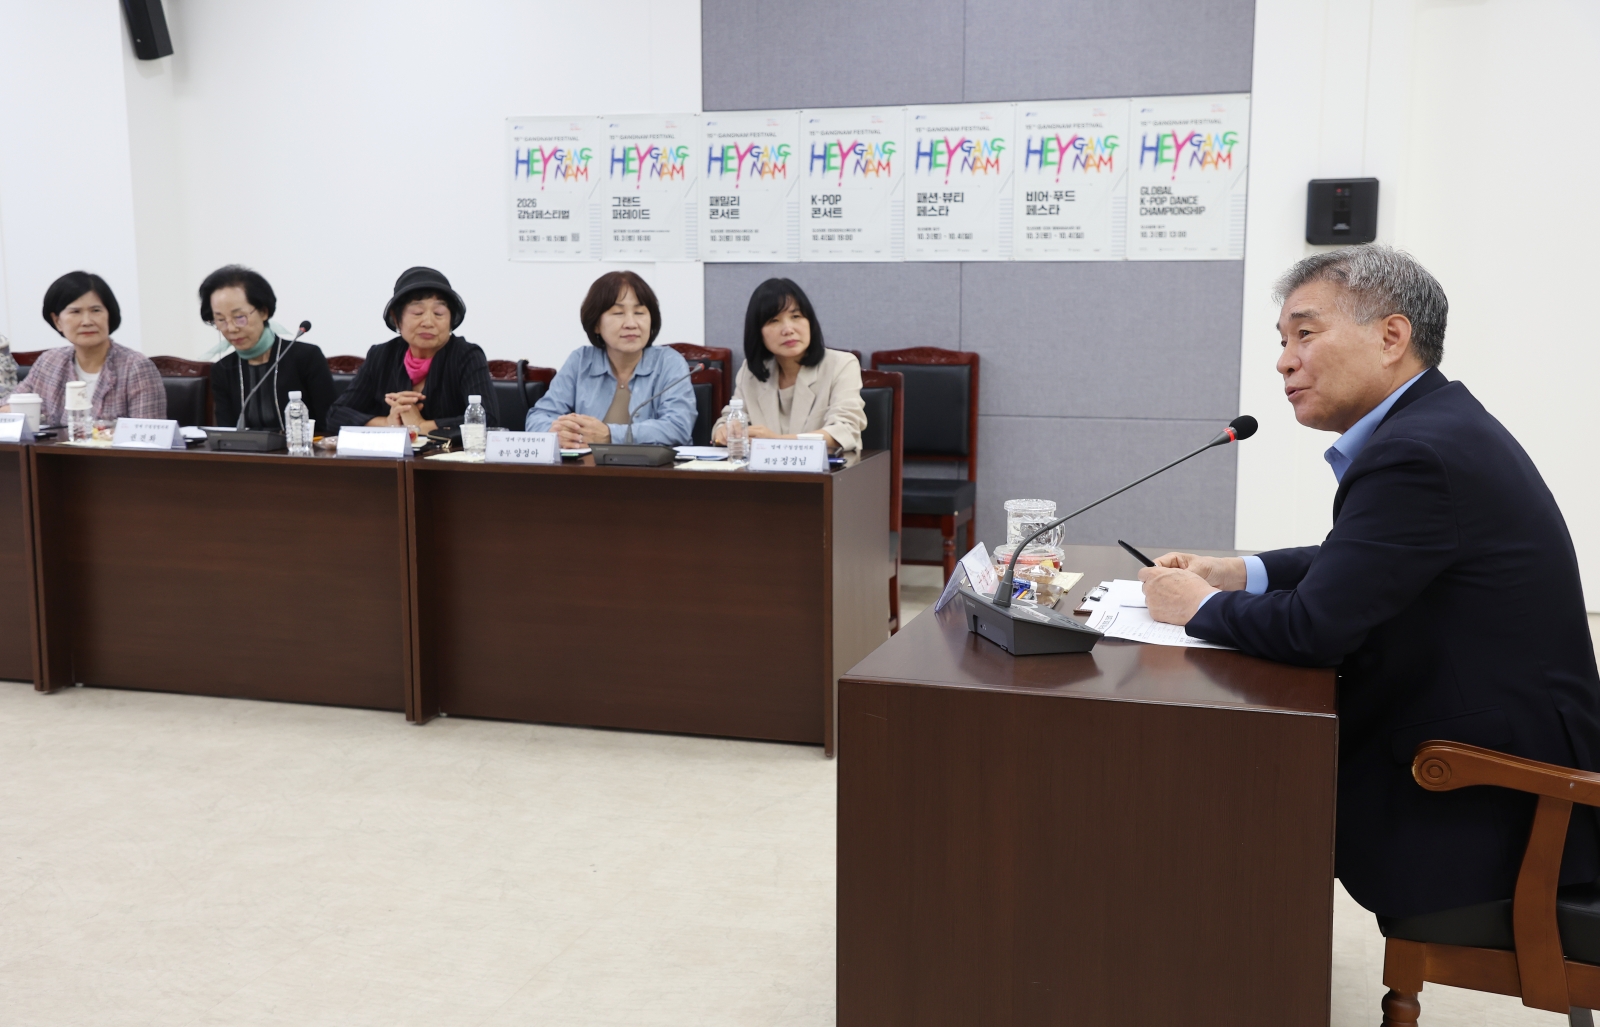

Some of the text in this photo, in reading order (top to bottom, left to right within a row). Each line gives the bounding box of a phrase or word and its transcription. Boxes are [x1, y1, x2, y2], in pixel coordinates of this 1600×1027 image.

[961, 138, 1006, 158] GANG
[1072, 135, 1120, 156] GANG
[1189, 132, 1239, 154] GANG
[553, 147, 593, 167] GANG
[650, 145, 689, 166] GANG
[750, 144, 792, 163] GANG
[853, 141, 896, 161] GANG
[853, 158, 891, 178] NAM
[960, 156, 1000, 176] NAM
[1072, 153, 1113, 174] NAM
[1188, 150, 1232, 171] NAM
[555, 163, 589, 182] NAM
[650, 162, 685, 181] NAM
[750, 161, 787, 180] NAM
[1140, 186, 1173, 196] GLOBAL
[517, 198, 537, 208] 2026
[612, 196, 640, 206] 그랜드
[709, 196, 740, 206] 패밀리
[811, 194, 842, 205] K-POP
[1140, 196, 1198, 206] K-POP DANCE
[518, 210, 570, 219] 강남페스티벌
[612, 209, 650, 220] 퍼레이드
[709, 208, 740, 220] 콘서트
[811, 208, 842, 218] 콘서트
[917, 206, 950, 216] 페스타
[1026, 204, 1060, 216] 페스타
[1140, 206, 1206, 216] CHAMPIONSHIP
[514, 448, 539, 458] 양정아
